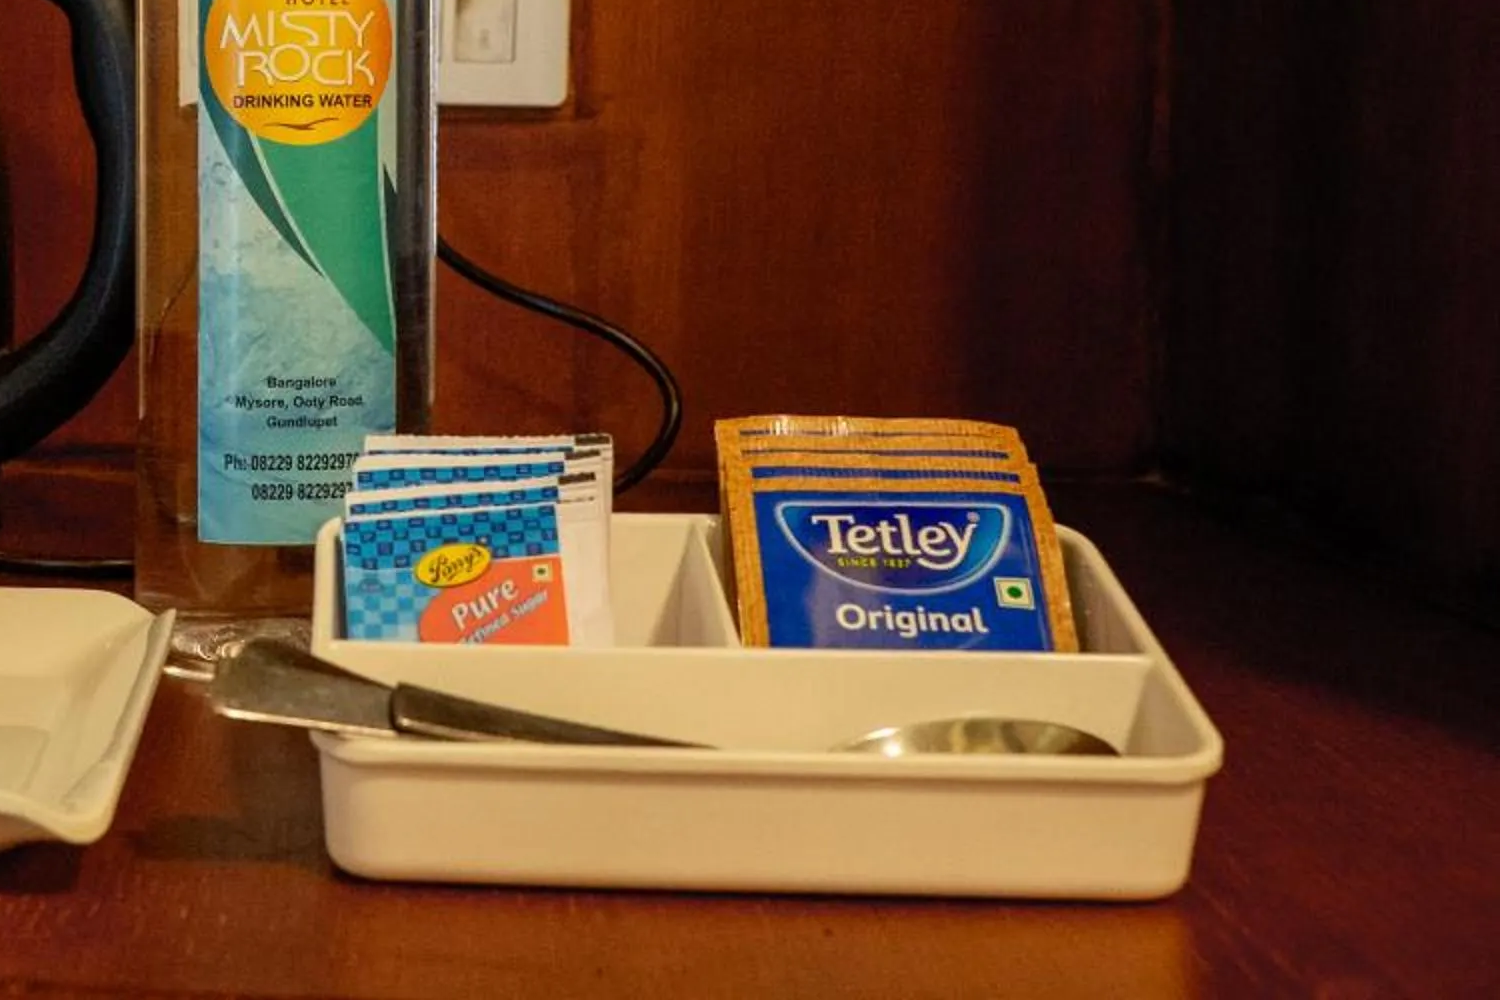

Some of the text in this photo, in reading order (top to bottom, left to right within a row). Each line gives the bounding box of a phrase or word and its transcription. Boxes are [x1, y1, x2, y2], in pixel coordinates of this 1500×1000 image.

[220, 10, 375, 48] MISTY
[235, 43, 375, 87] ROCK
[233, 93, 373, 109] DRINKING WATER
[267, 375, 337, 390] Bangalore
[235, 396, 289, 411] Mysore,
[293, 396, 326, 409] Ooty
[266, 415, 338, 430] Gundlupet
[251, 483, 293, 500] 08229
[811, 511, 978, 571] Tetley
[837, 556, 878, 569] SINCE
[451, 577, 519, 633] Pure
[836, 603, 989, 638] Original
